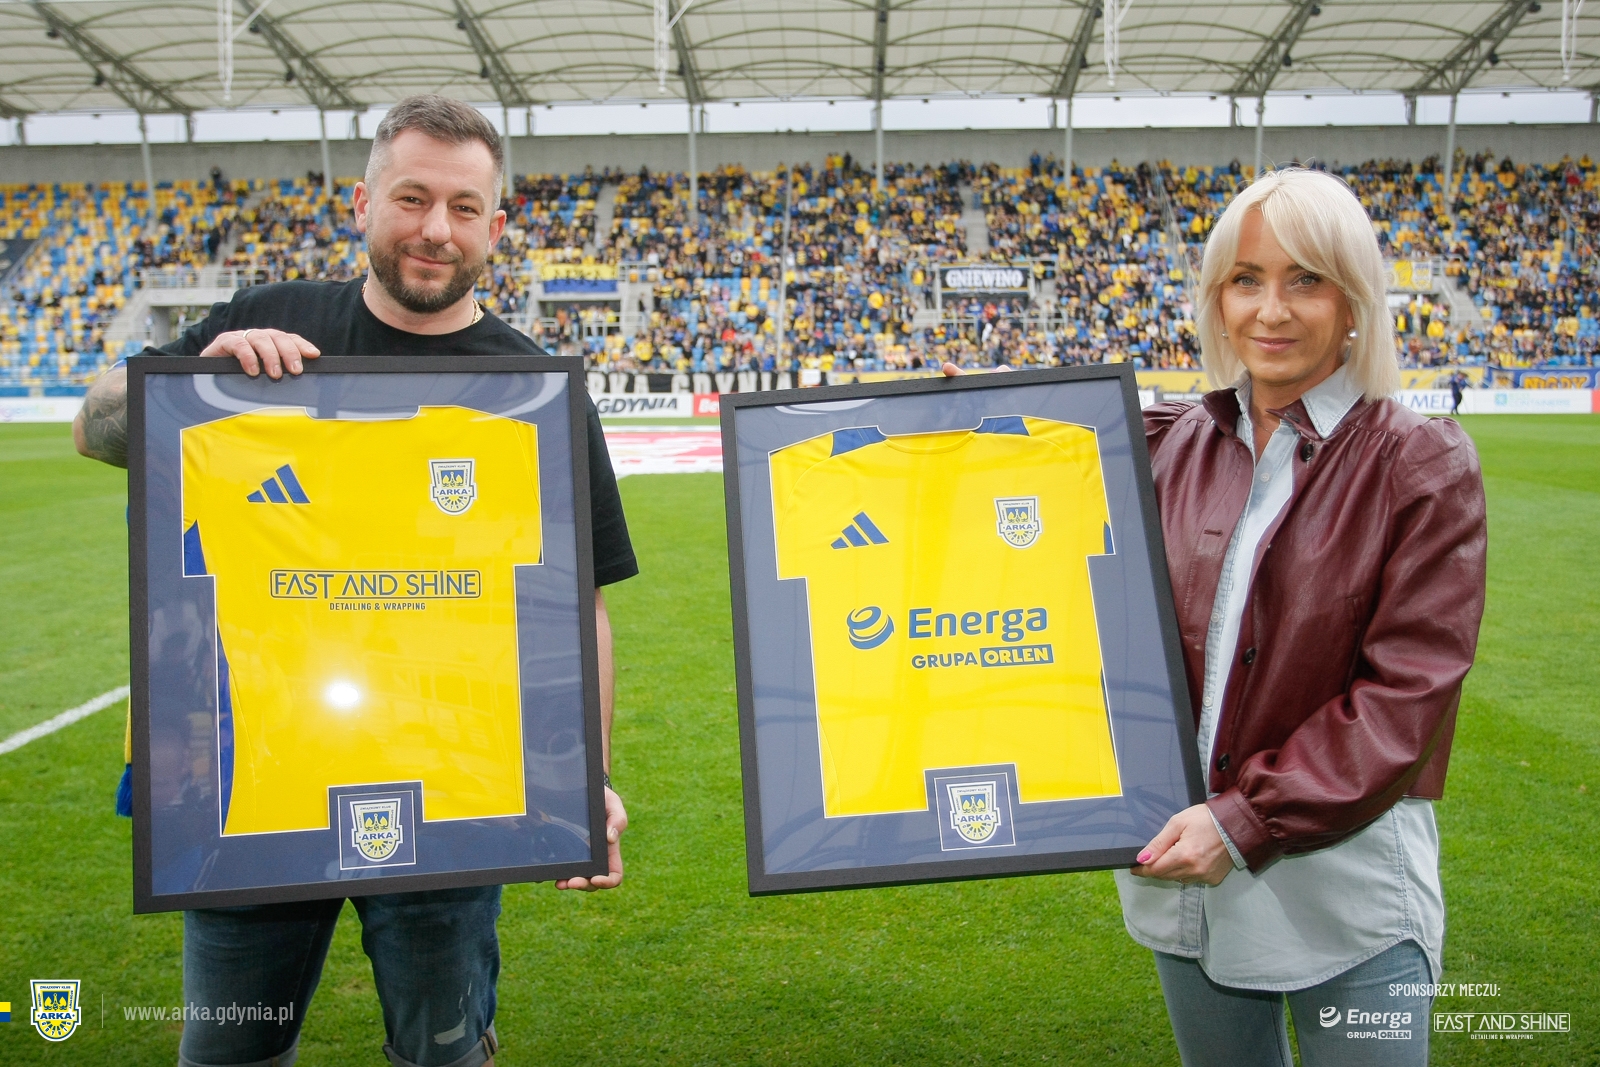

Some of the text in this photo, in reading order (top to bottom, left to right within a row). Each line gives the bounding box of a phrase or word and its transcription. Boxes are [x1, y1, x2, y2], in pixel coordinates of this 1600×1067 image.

[946, 269, 1024, 288] GNIEWINO
[585, 372, 793, 393] RKA GDYNIA
[597, 398, 677, 413] GDYNIA
[275, 570, 478, 599] FAST AND SHINE
[329, 602, 426, 611] DETAILING & WRAPPING
[908, 607, 1048, 642] Energa
[911, 647, 1050, 669] GRUPA ORLEN
[960, 814, 992, 823] ARKA
[361, 832, 394, 840] ARKA
